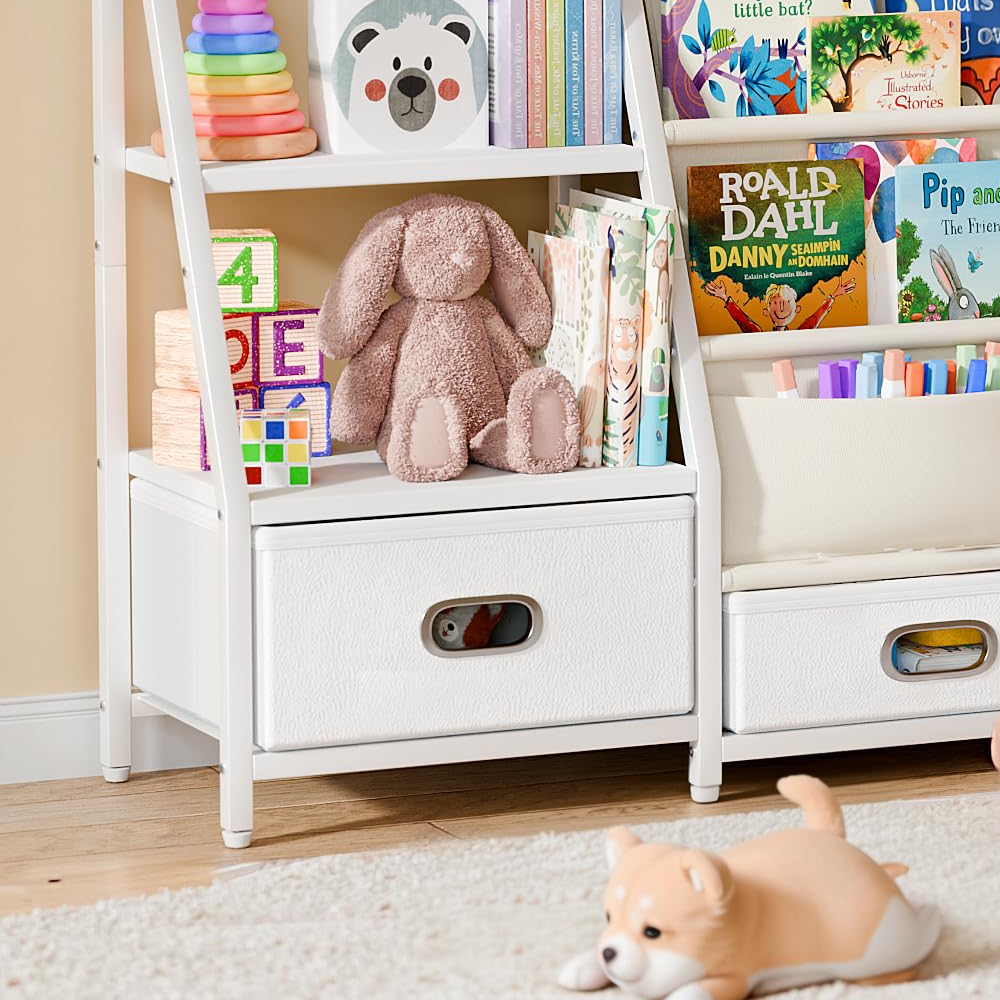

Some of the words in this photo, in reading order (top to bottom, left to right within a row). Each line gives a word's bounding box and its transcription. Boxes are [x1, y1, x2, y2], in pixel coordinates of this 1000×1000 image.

[734, 2, 773, 18] little
[895, 95, 944, 109] Stories
[719, 166, 837, 204] ROALD
[922, 172, 965, 214] Pip
[720, 200, 838, 241] DAHL
[941, 218, 963, 235] The
[709, 244, 789, 273] DANNY
[798, 254, 849, 268] DOMHAIN
[217, 246, 259, 304] 4
[769, 271, 795, 279] Quentin
[273, 319, 306, 377] E
